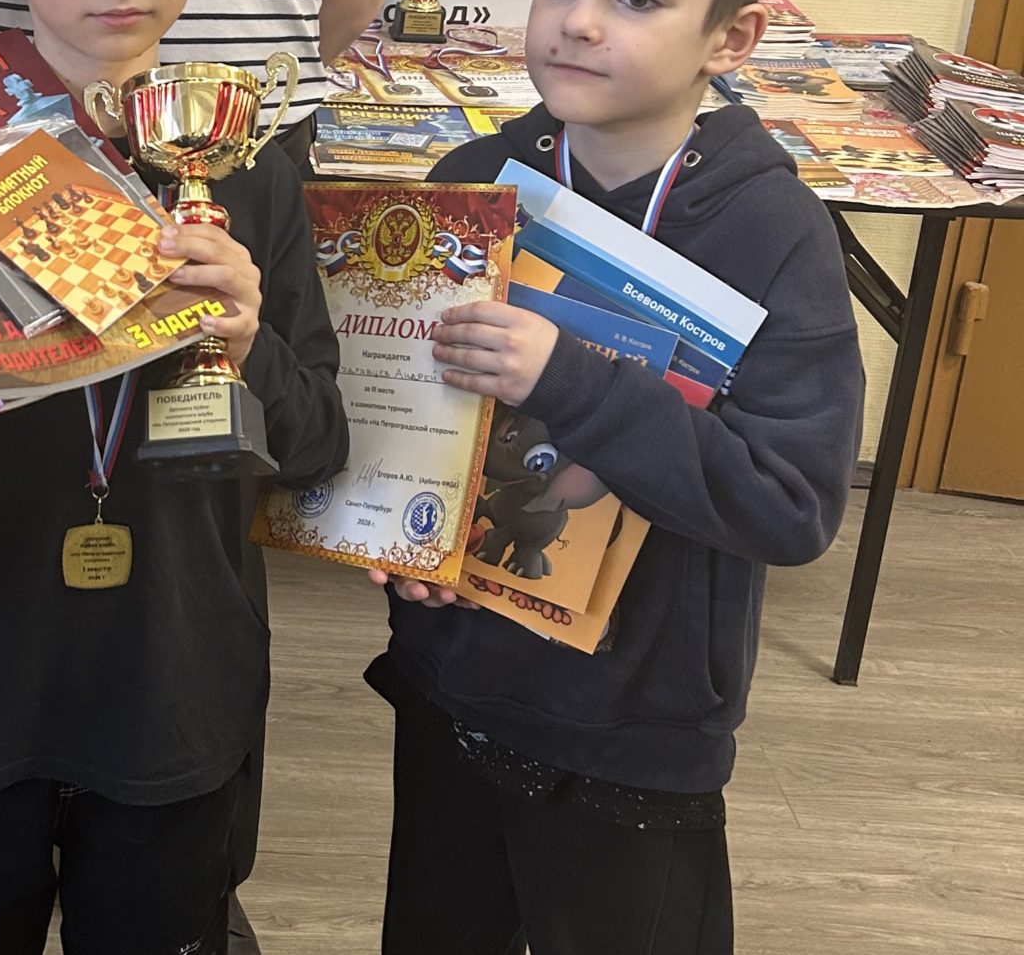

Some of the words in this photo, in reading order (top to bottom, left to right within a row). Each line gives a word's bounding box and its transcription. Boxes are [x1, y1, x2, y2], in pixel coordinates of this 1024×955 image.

[622, 281, 678, 324] Всеволод
[678, 314, 727, 352] Костров
[126, 324, 153, 350] 3
[150, 299, 227, 339] ЧАСТЬ
[336, 313, 439, 341] ДИПЛОМ
[362, 350, 411, 362] Награждается
[156, 391, 223, 404] ПОБЕДИТЕЛЬ
[387, 405, 414, 414] турнире
[380, 419, 428, 433] Петроградской
